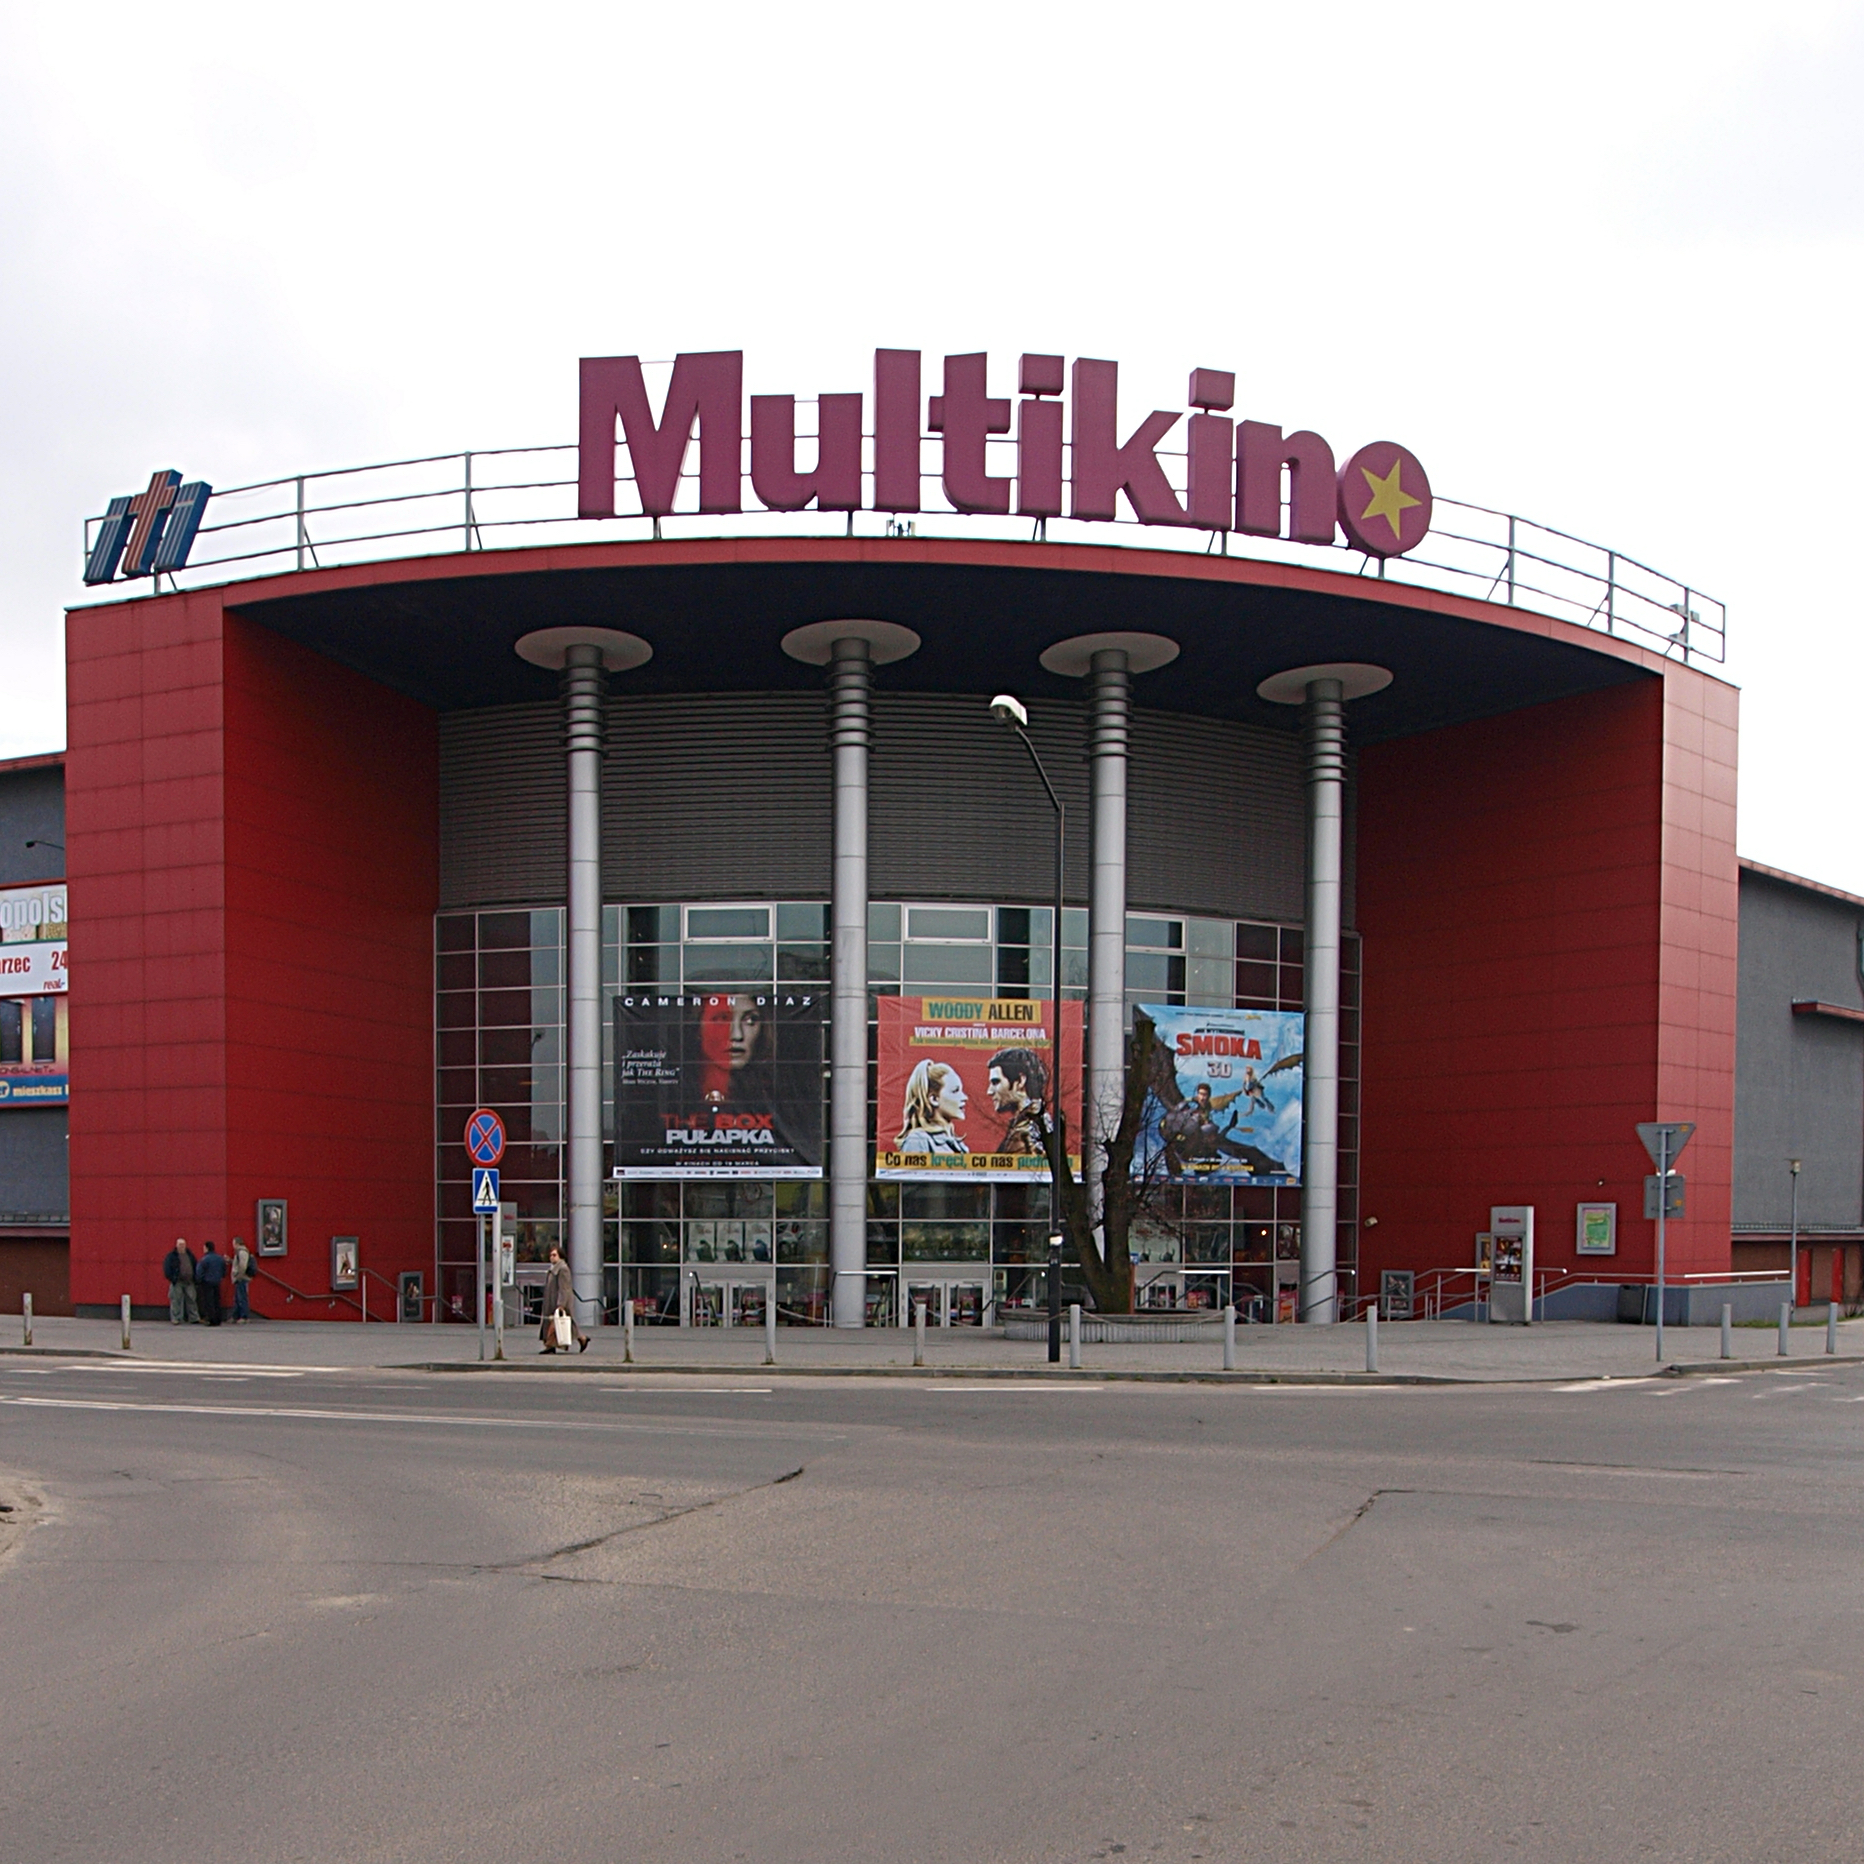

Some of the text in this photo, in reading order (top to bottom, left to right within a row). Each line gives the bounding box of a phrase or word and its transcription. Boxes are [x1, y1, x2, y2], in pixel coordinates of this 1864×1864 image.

[577, 348, 1434, 560] Multikino
[0, 956, 31, 974] rzec
[624, 996, 811, 1007] CAMERON DIAZ
[929, 1003, 1033, 1021] WOODY ALLEN
[914, 1027, 1046, 1040] VICKY CRISTINA BARCELONA
[1176, 1033, 1263, 1061] SMOKA
[1207, 1062, 1233, 1079] 3D
[660, 1113, 774, 1129] THE BOX
[666, 1129, 774, 1144] PUŁAPKA
[885, 1153, 900, 1167] Co
[905, 1155, 927, 1167] nas
[972, 1156, 987, 1168] co
[991, 1156, 1014, 1168] nas
